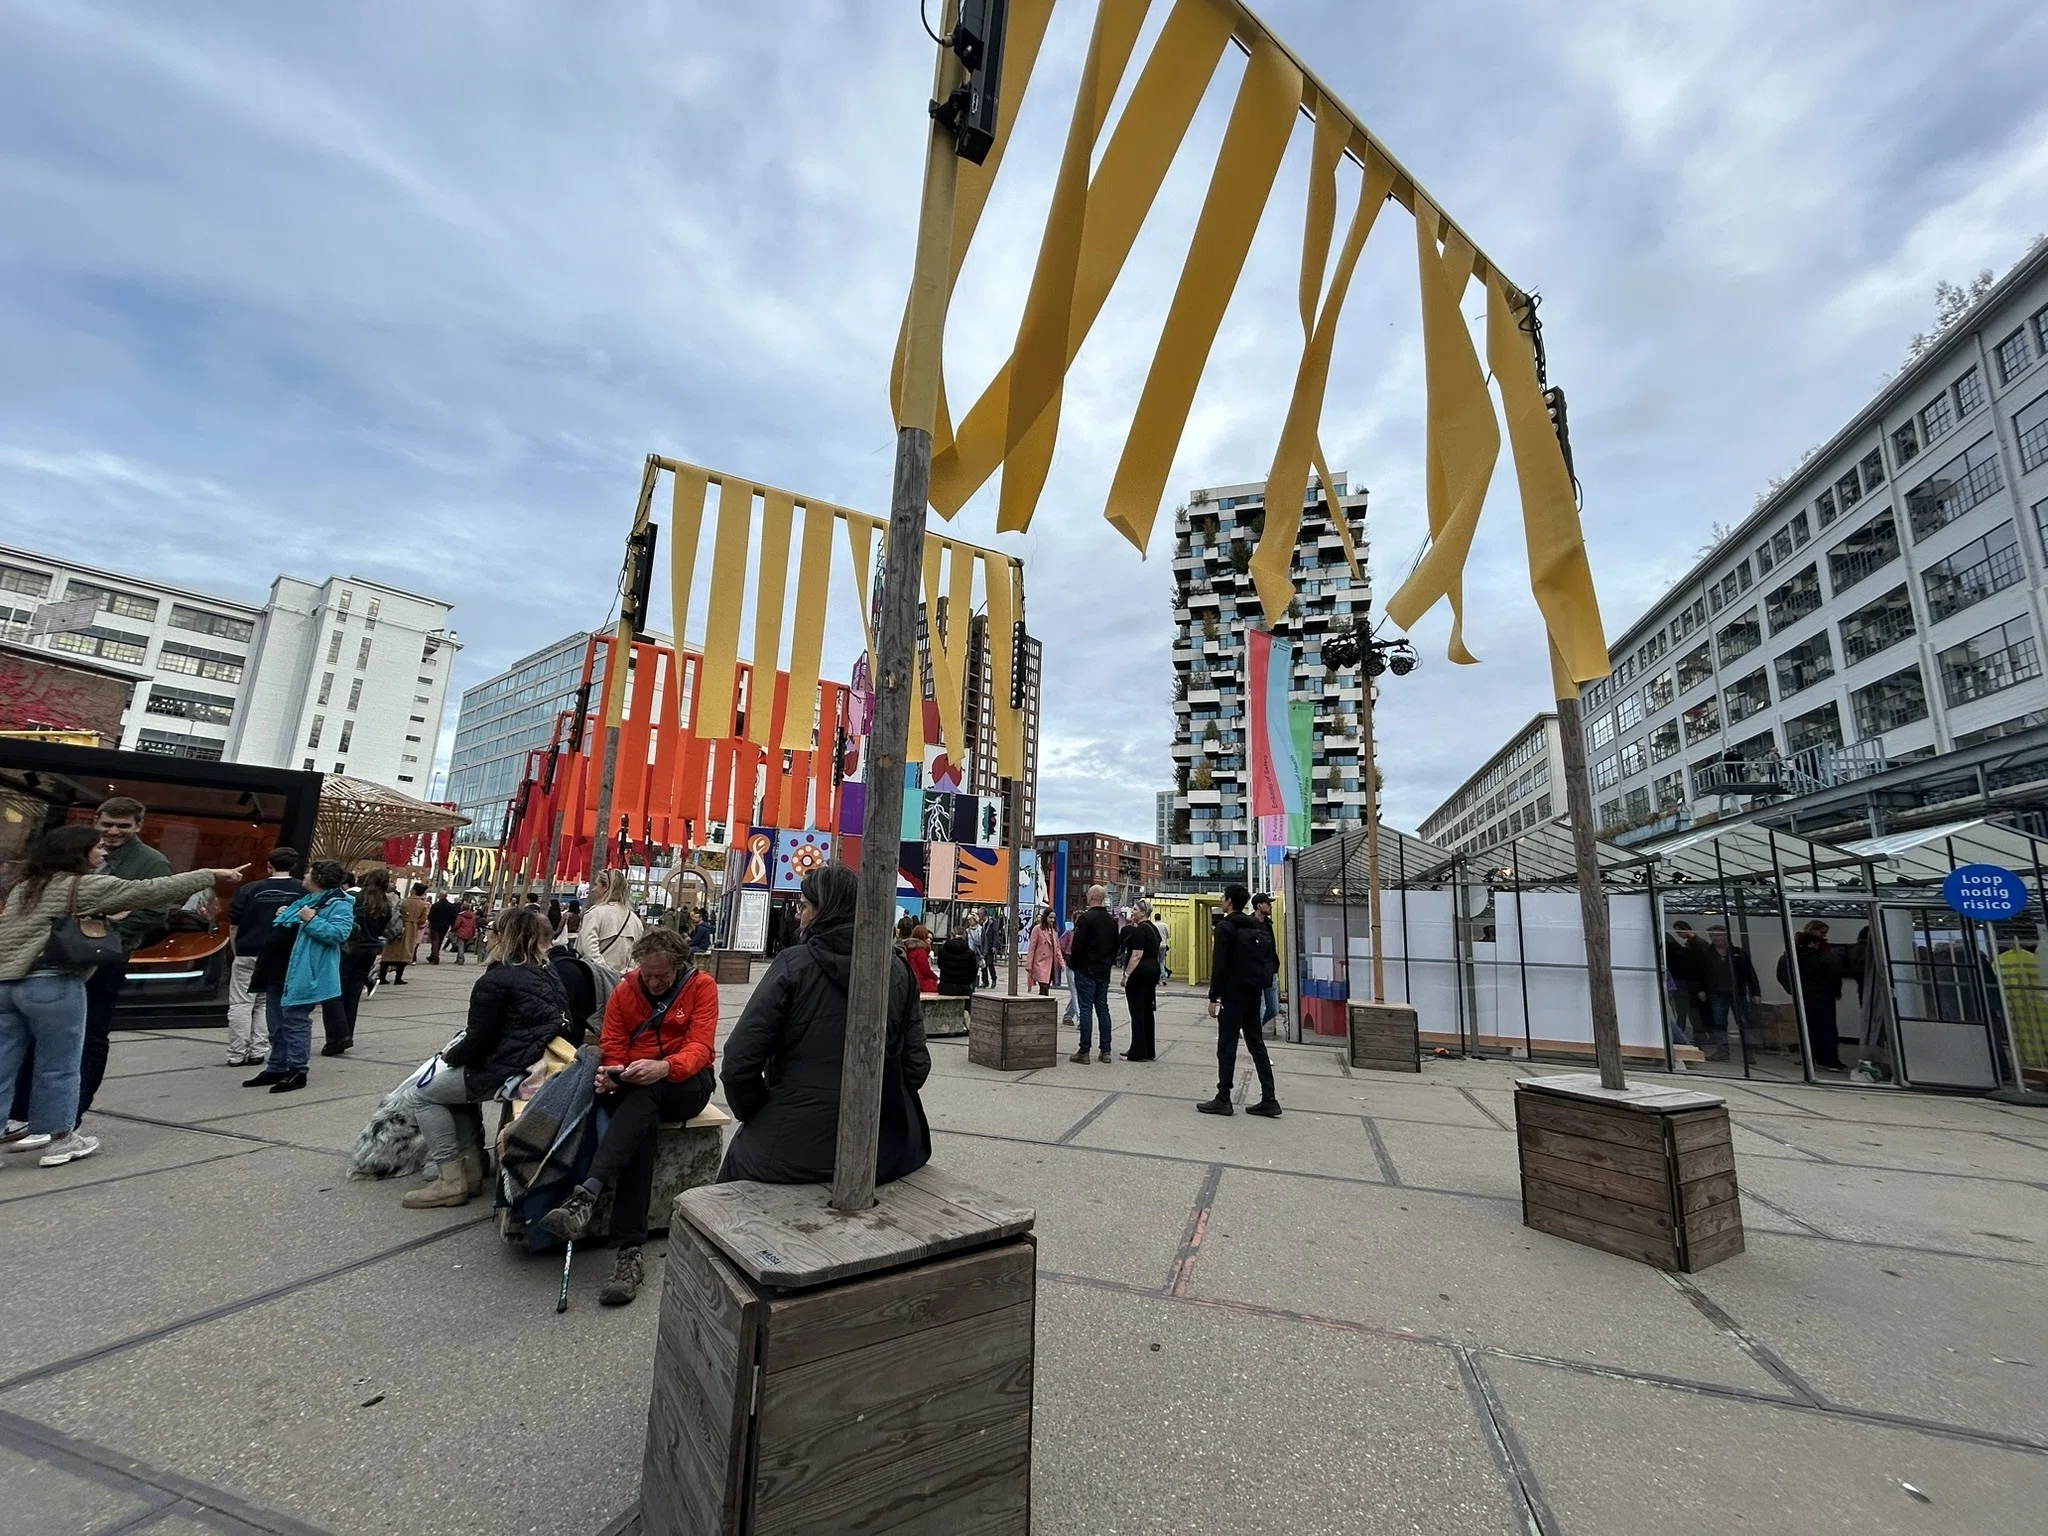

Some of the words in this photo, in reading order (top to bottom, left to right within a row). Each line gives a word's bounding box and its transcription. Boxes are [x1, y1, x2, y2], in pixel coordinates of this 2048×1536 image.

[1962, 874, 2002, 886] Loop
[1960, 887, 2009, 899] nodig
[1963, 899, 2011, 909] risico
